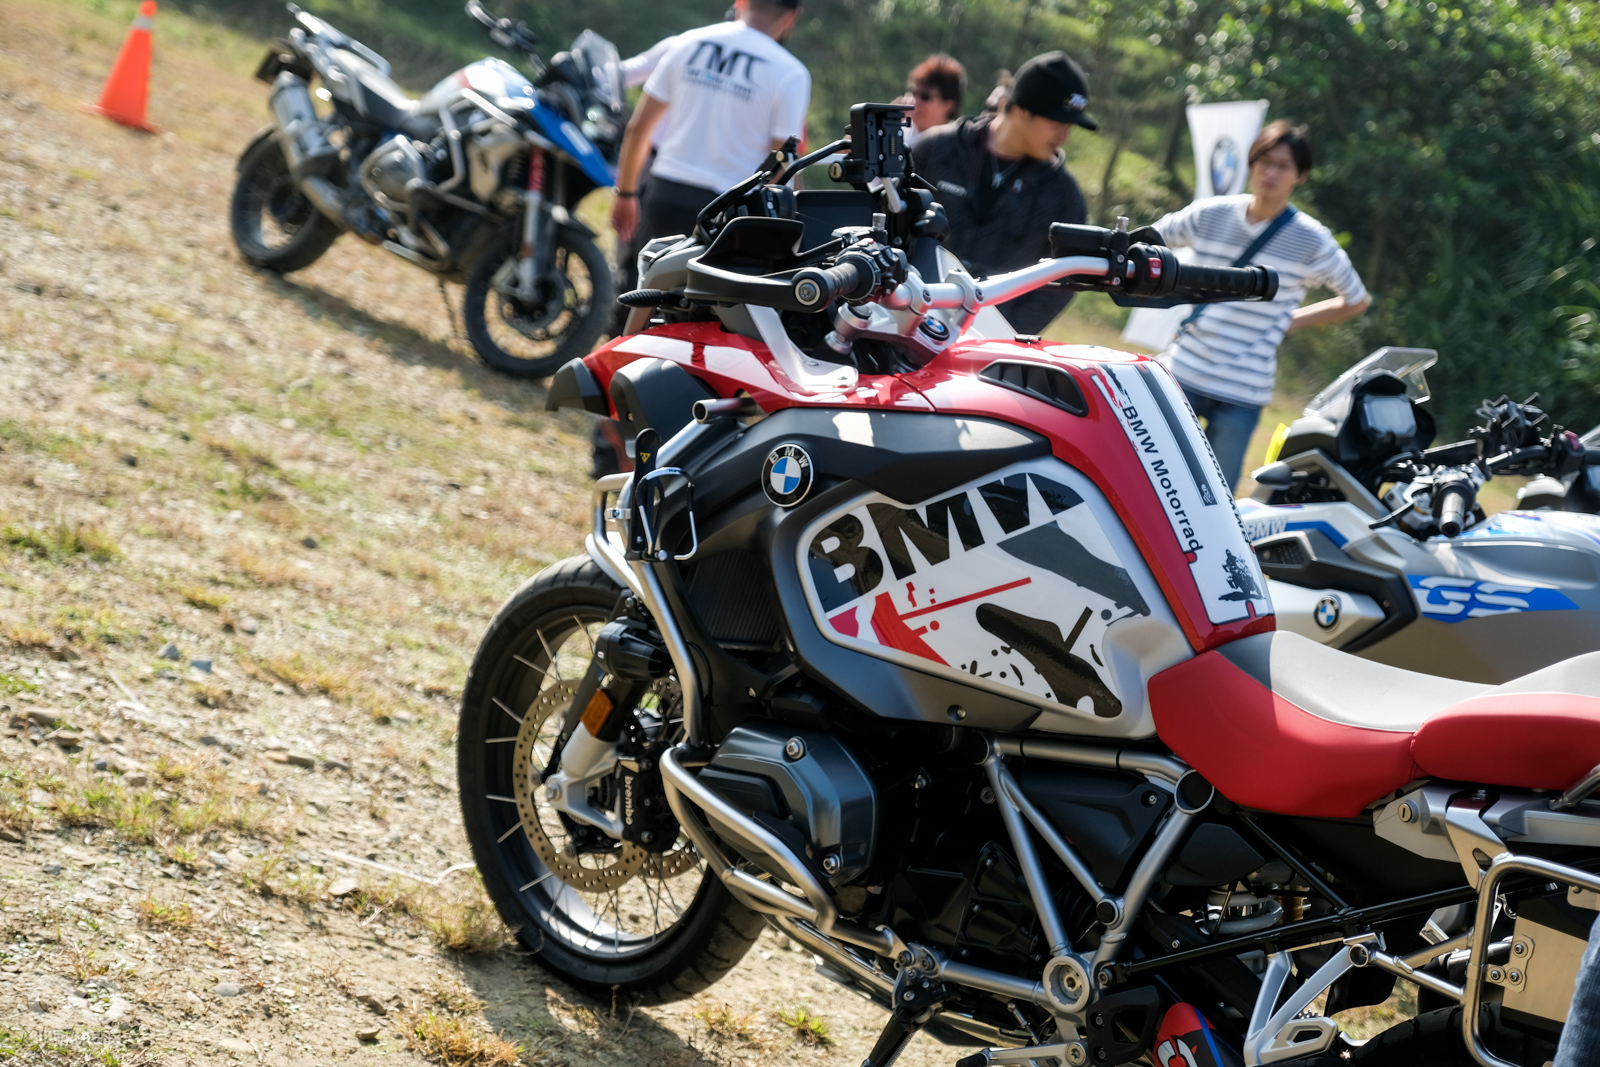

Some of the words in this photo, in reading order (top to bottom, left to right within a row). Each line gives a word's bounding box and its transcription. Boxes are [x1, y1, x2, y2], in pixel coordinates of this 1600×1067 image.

[769, 446, 809, 468] BMW
[1122, 405, 1159, 455] BMW
[1151, 459, 1203, 551] Motorrad
[808, 472, 1085, 613] BMW
[1246, 516, 1288, 541] BMW
[1413, 576, 1535, 618] GS
[624, 776, 634, 825] brembo
